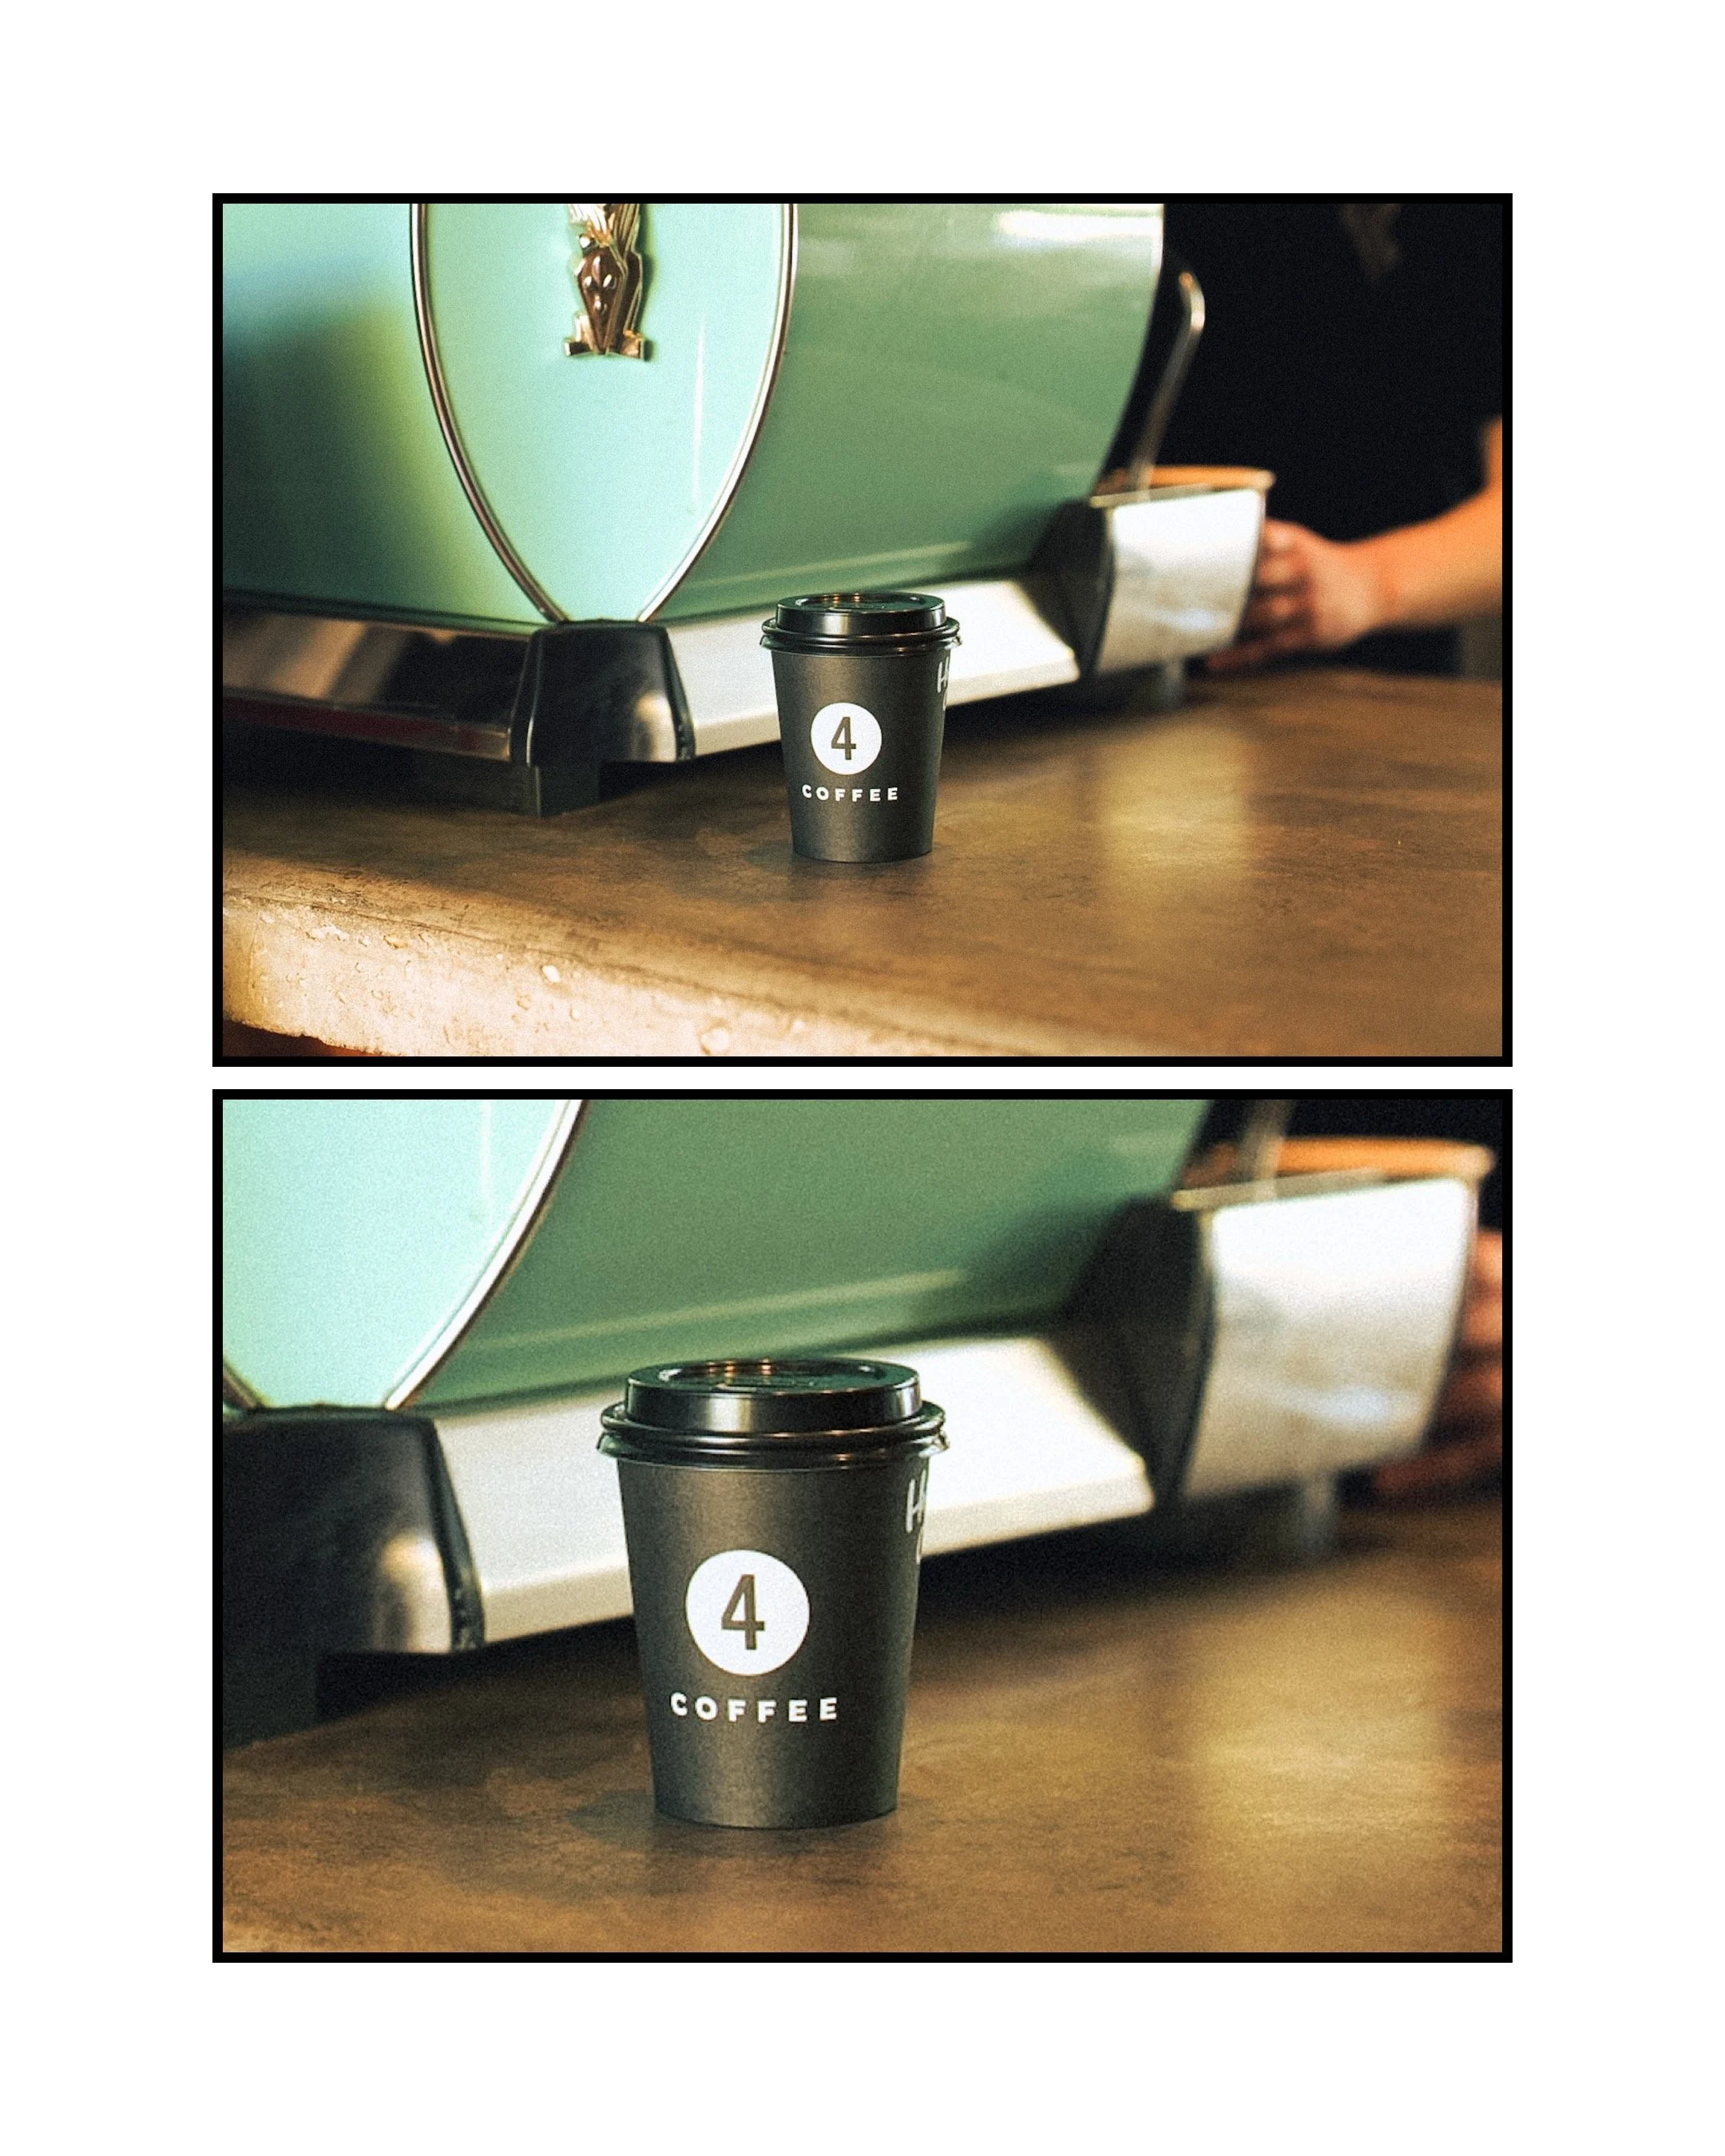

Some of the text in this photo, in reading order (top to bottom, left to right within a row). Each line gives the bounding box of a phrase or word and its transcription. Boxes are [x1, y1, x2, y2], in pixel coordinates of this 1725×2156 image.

[831, 716, 857, 761] 4
[802, 784, 898, 803] COFFEE
[721, 1574, 765, 1651] 4
[670, 1692, 838, 1723] COFFEE
